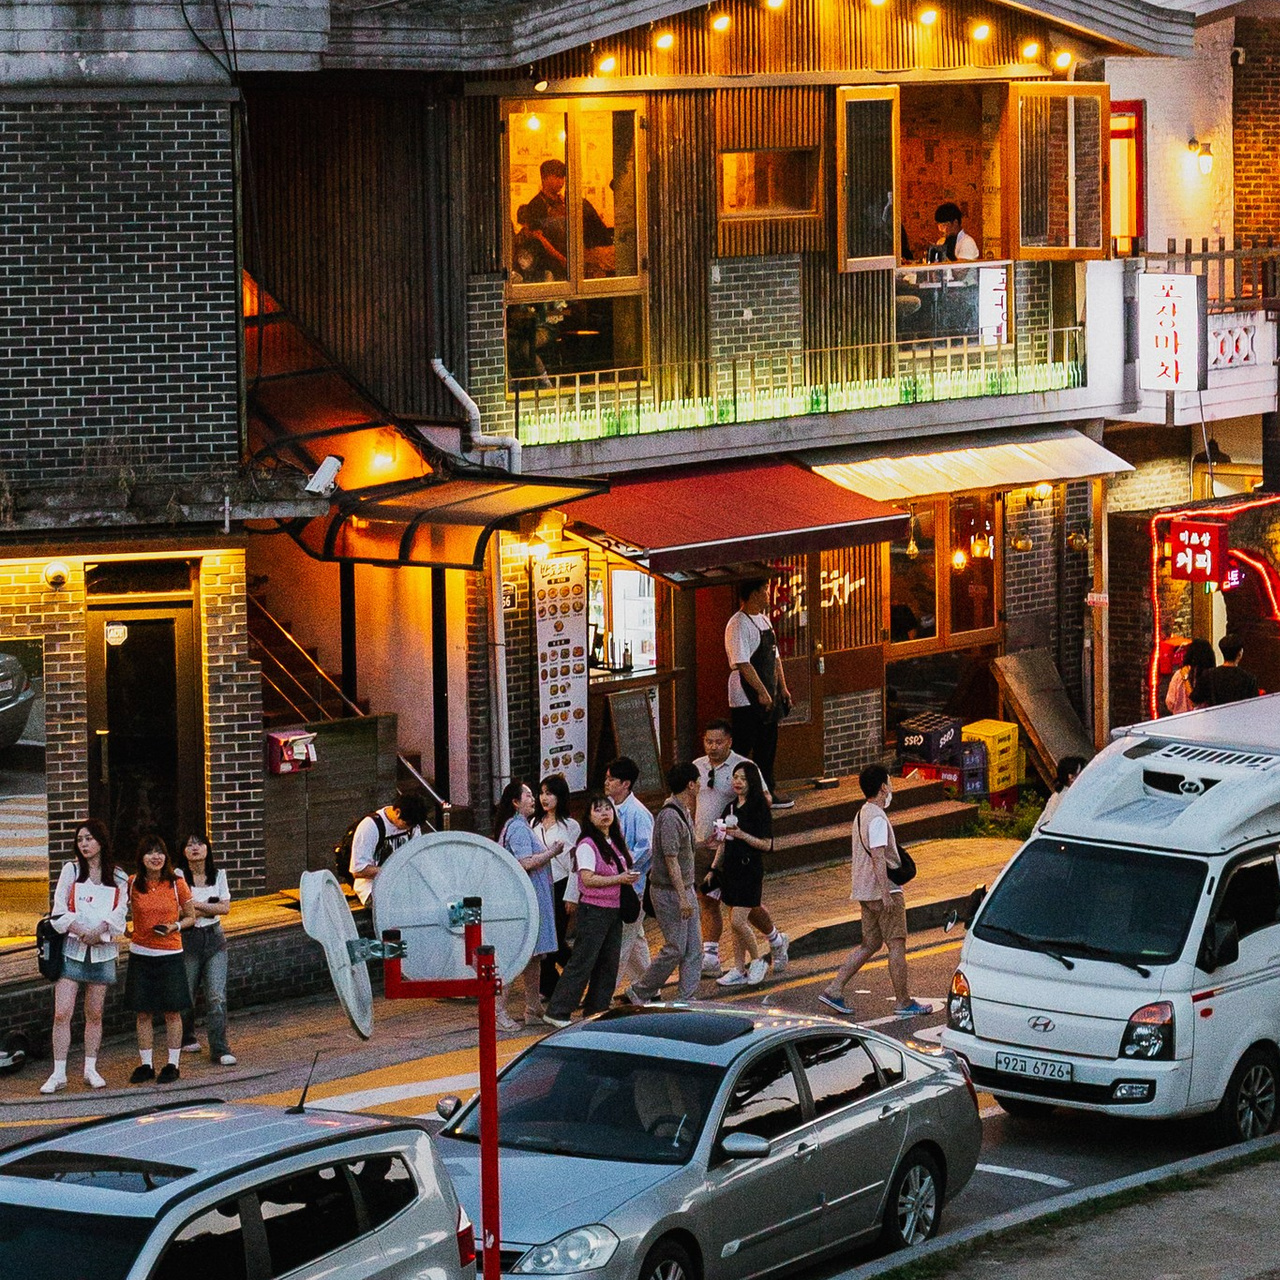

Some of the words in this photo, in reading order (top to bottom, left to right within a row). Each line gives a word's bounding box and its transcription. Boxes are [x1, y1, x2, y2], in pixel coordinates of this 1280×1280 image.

[1153, 279, 1183, 385] 포장마차
[1176, 547, 1212, 576] 커피
[1032, 1061, 1065, 1078] 6726
